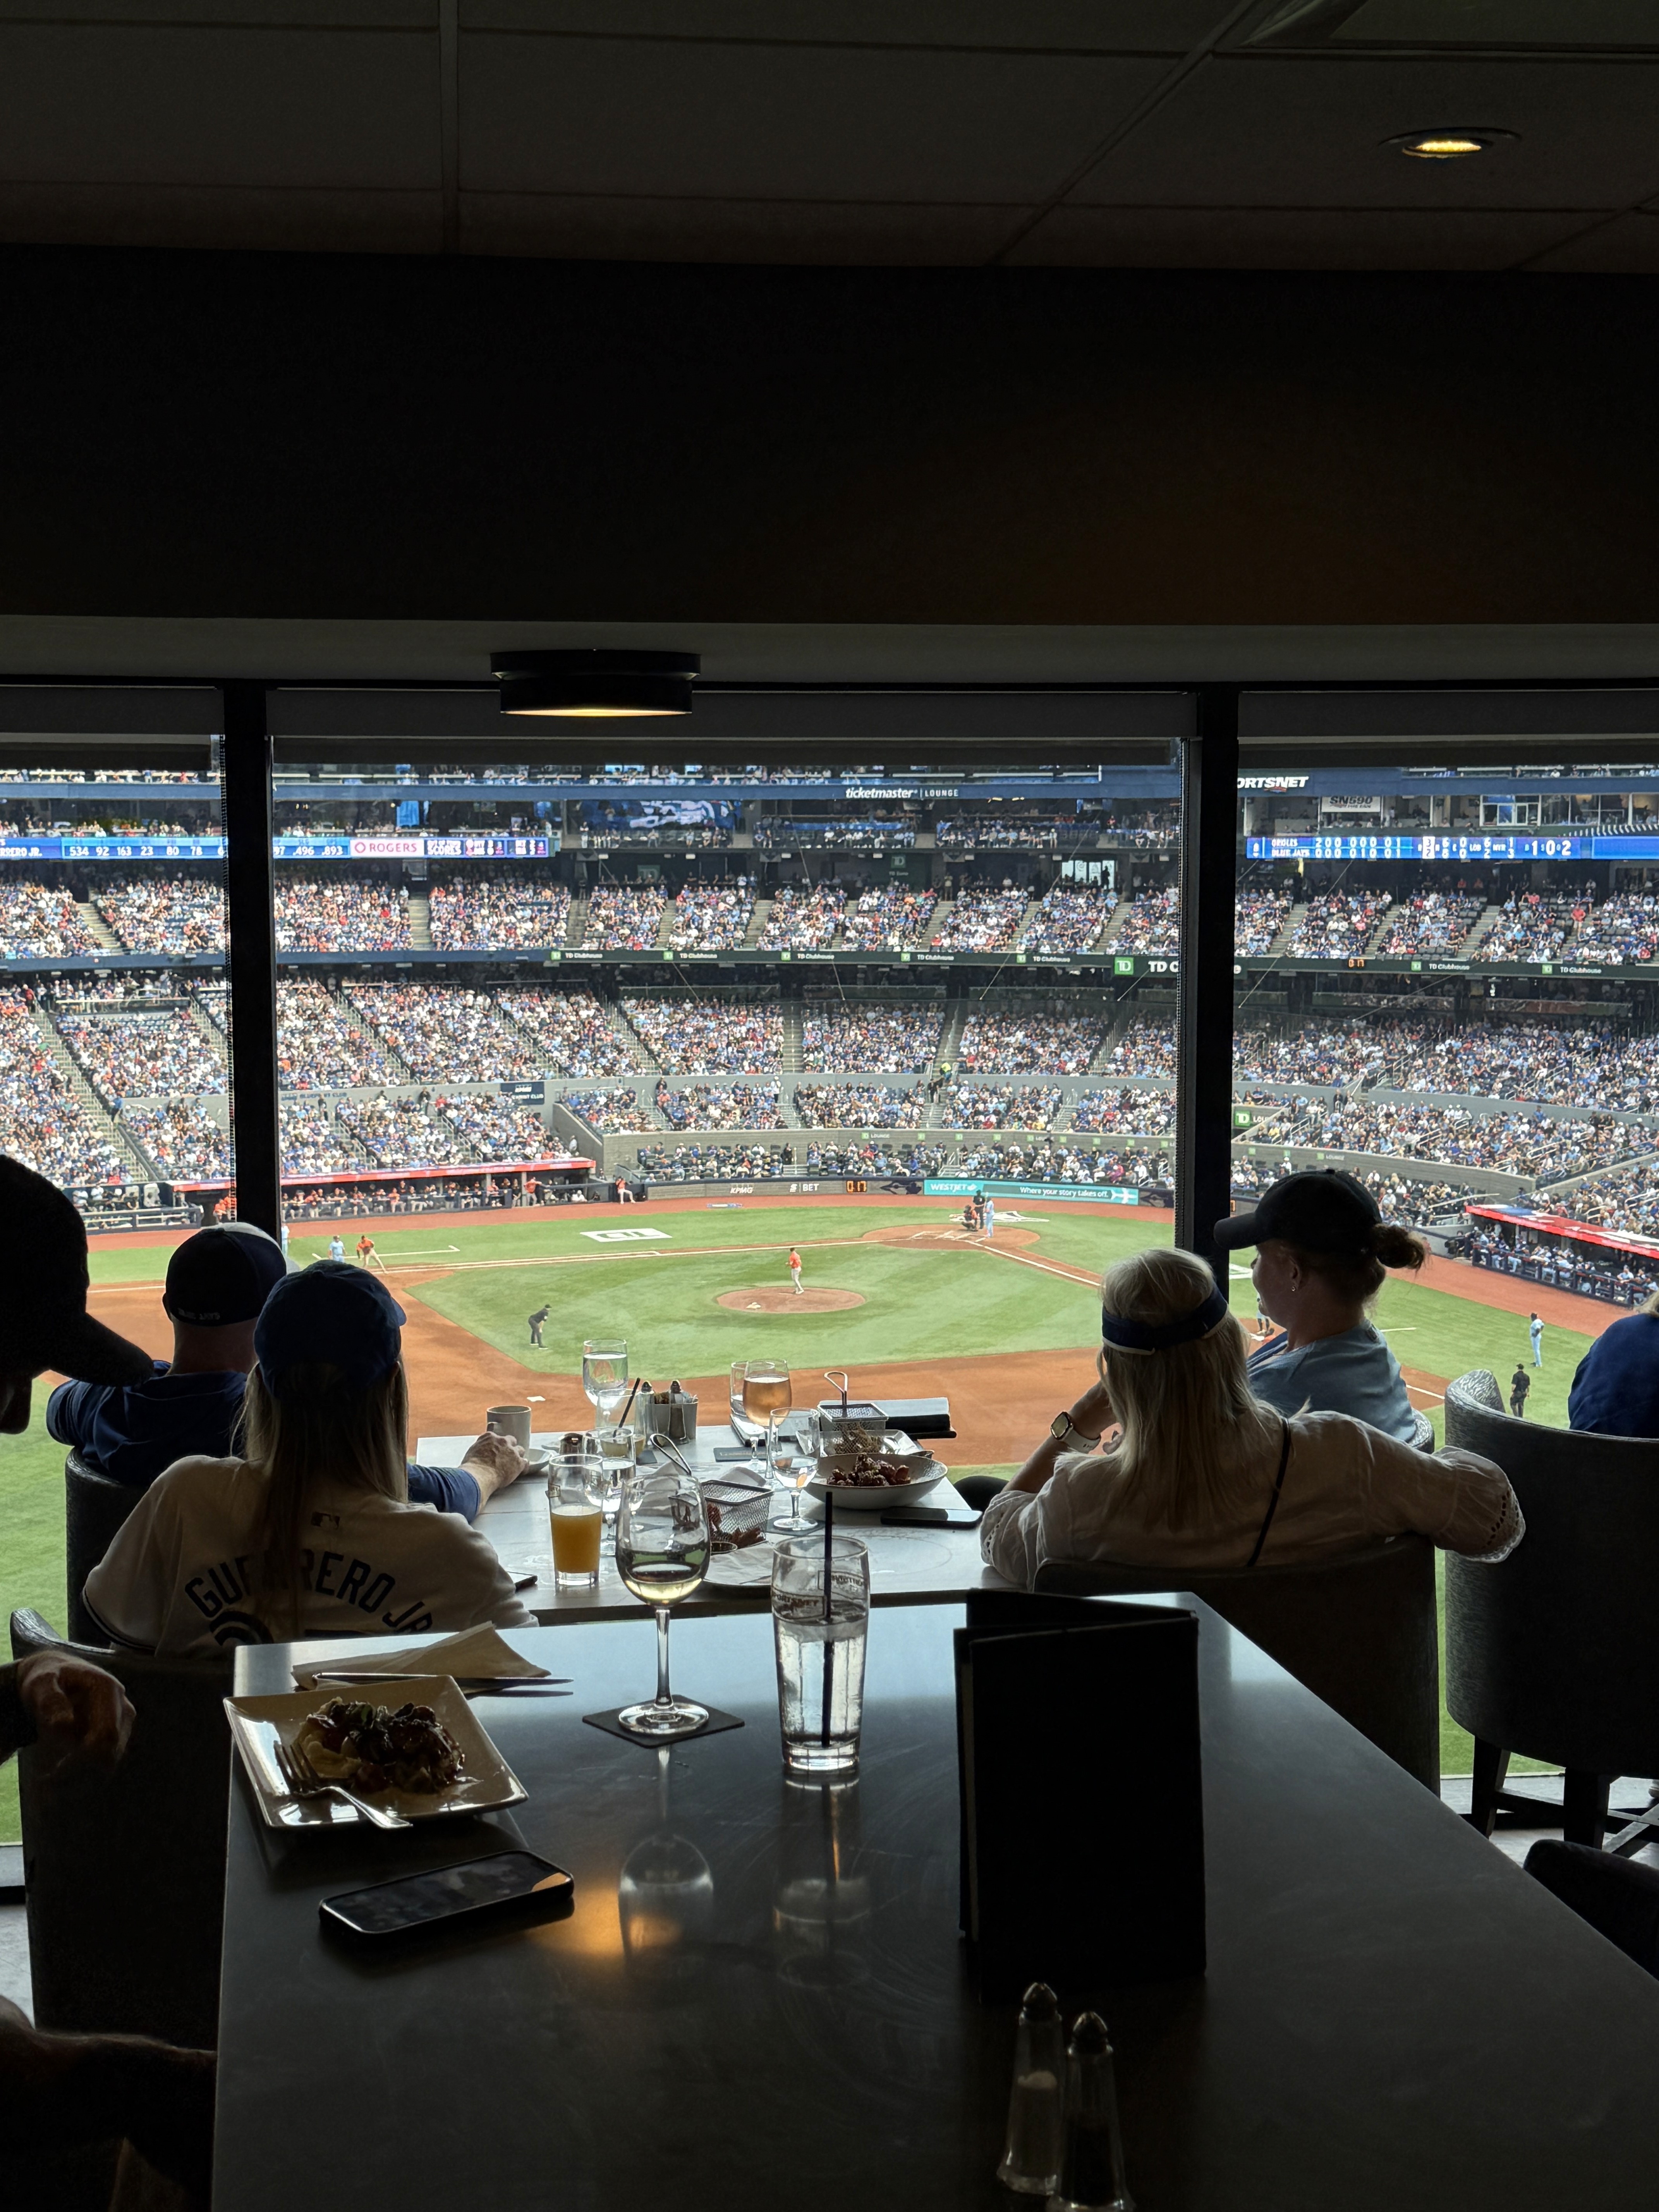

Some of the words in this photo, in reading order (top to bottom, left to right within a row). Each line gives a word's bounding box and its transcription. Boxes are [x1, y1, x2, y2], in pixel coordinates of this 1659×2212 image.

[1237, 776, 1309, 788] ORTSNET
[846, 787, 914, 798] ticketmaster
[1329, 796, 1373, 804] SN590
[1316, 837, 1322, 847] 2
[1325, 837, 1331, 847] 0
[1334, 837, 1341, 847] 0
[1350, 837, 1356, 847] 0
[1360, 837, 1366, 847] 0
[1370, 837, 1376, 847] 0
[1385, 837, 1391, 847] 0
[0, 847, 27, 857] RRERO
[70, 846, 89, 856] 534
[96, 846, 110, 856] 92
[117, 846, 132, 856] 163
[141, 846, 153, 856] 23
[274, 846, 285, 855] 97
[293, 846, 314, 855] .496
[369, 843, 417, 852] ROGERS
[428, 845, 462, 855] SCORES
[1532, 840, 1537, 855] 1
[1546, 840, 1555, 855] 0
[1562, 840, 1571, 855] 2
[1316, 848, 1322, 858] 0
[1325, 848, 1331, 858] 0
[1334, 848, 1341, 858] 0
[1350, 848, 1356, 858] 0
[1370, 848, 1376, 858] 0
[1384, 848, 1391, 858] 0
[1117, 960, 1131, 971] TD
[1148, 961, 1167, 972] TD
[1236, 1113, 1249, 1123] TD
[930, 1183, 967, 1192] WESTJET
[1059, 1189, 1076, 1197] story
